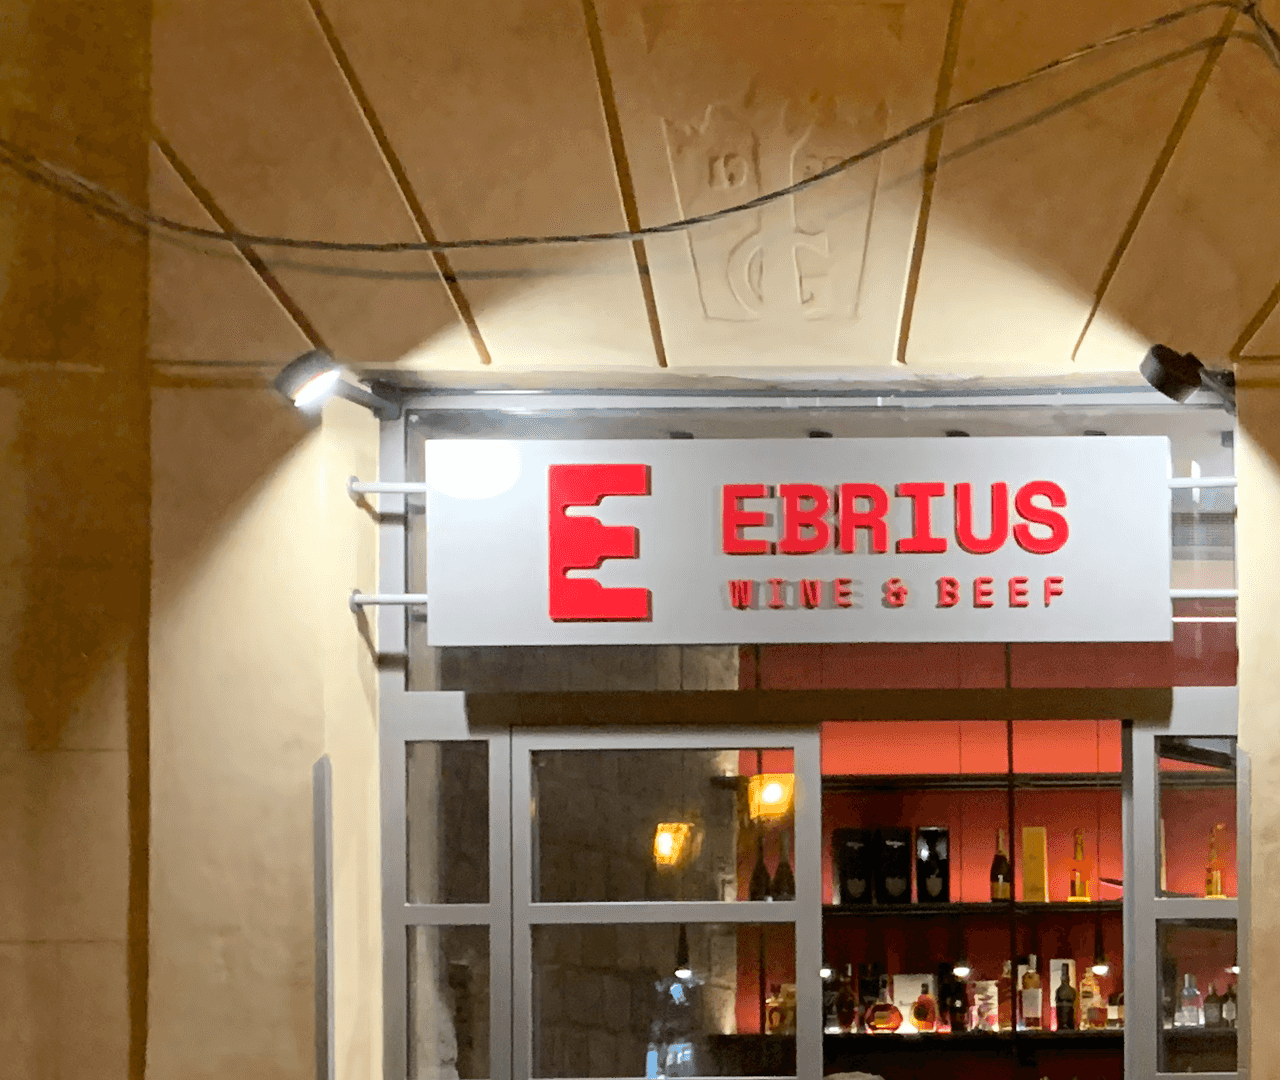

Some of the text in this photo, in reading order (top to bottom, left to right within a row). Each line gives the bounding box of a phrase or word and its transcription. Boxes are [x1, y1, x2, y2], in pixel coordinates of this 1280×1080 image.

[721, 480, 1071, 557] EBRIUS
[727, 575, 1066, 609] WINE & BEEF
